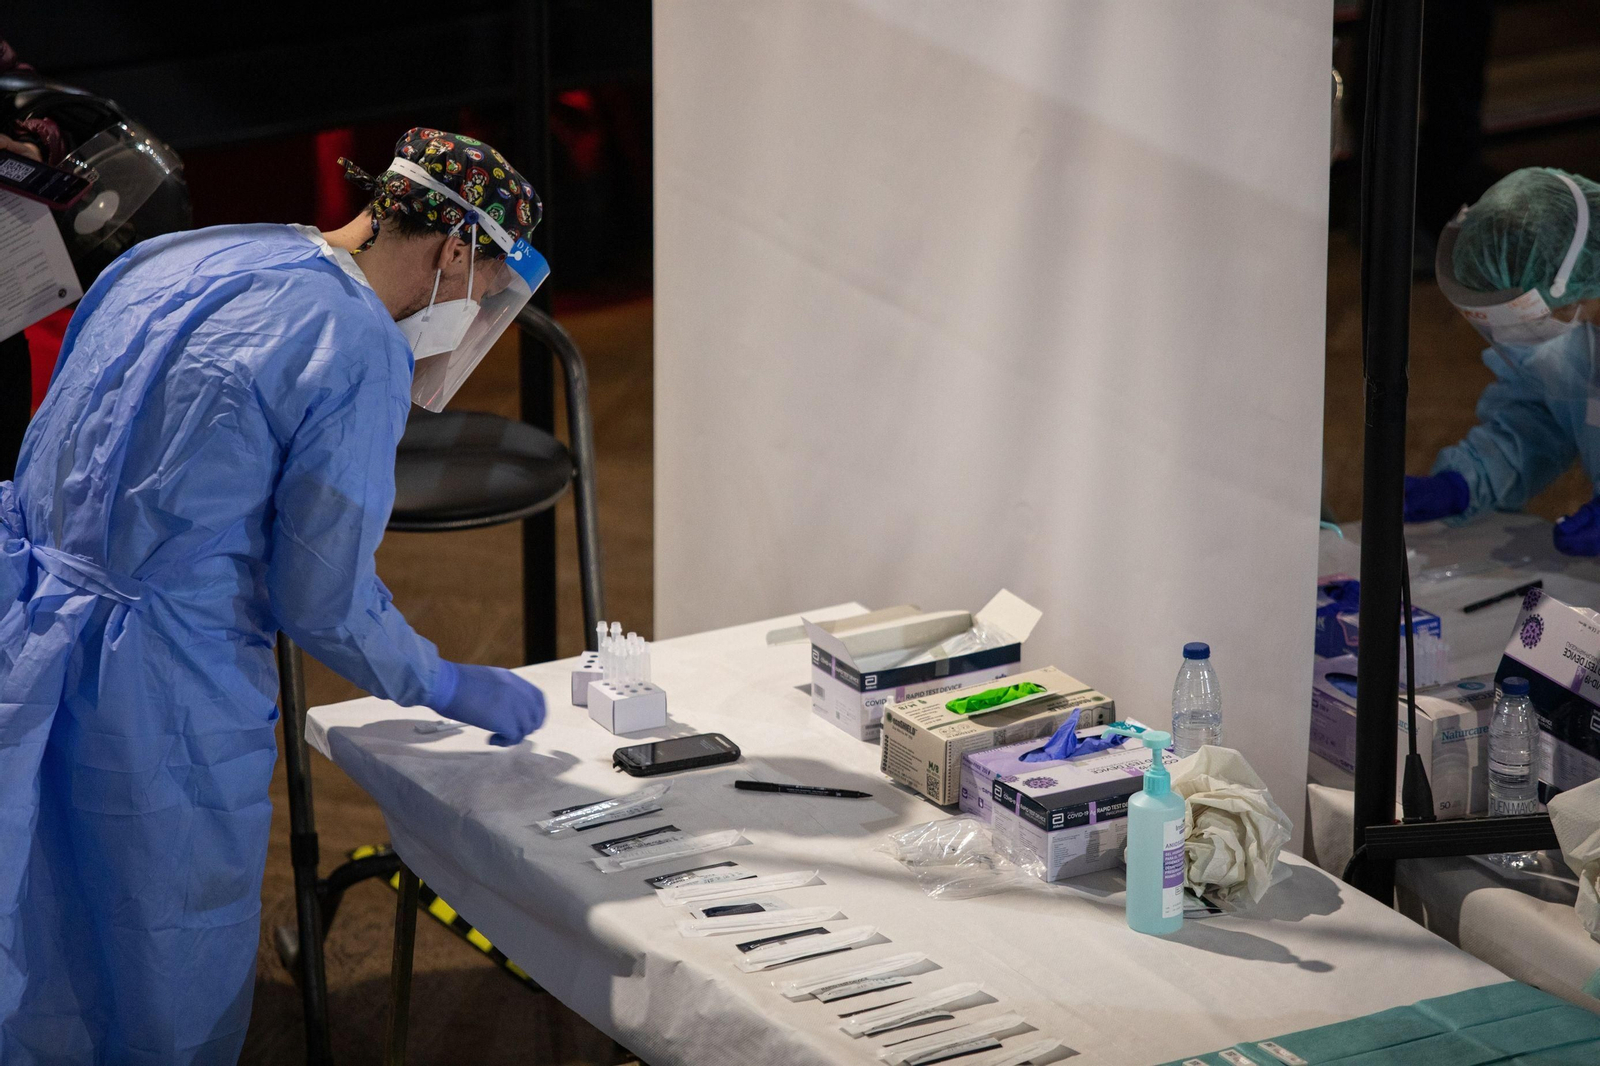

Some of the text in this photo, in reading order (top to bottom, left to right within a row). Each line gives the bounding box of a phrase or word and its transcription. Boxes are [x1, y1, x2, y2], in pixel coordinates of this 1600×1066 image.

[1562, 647, 1598, 675] TEST DEVICE
[906, 691, 925, 701] RAPID
[925, 688, 939, 697] TEST
[939, 683, 962, 694] DEVICE
[1441, 725, 1490, 741] Naturcare
[1067, 811, 1089, 820] COVID-19
[1096, 806, 1112, 814] RAPID
[1111, 803, 1122, 811] TEST
[1439, 801, 1451, 811] 50
